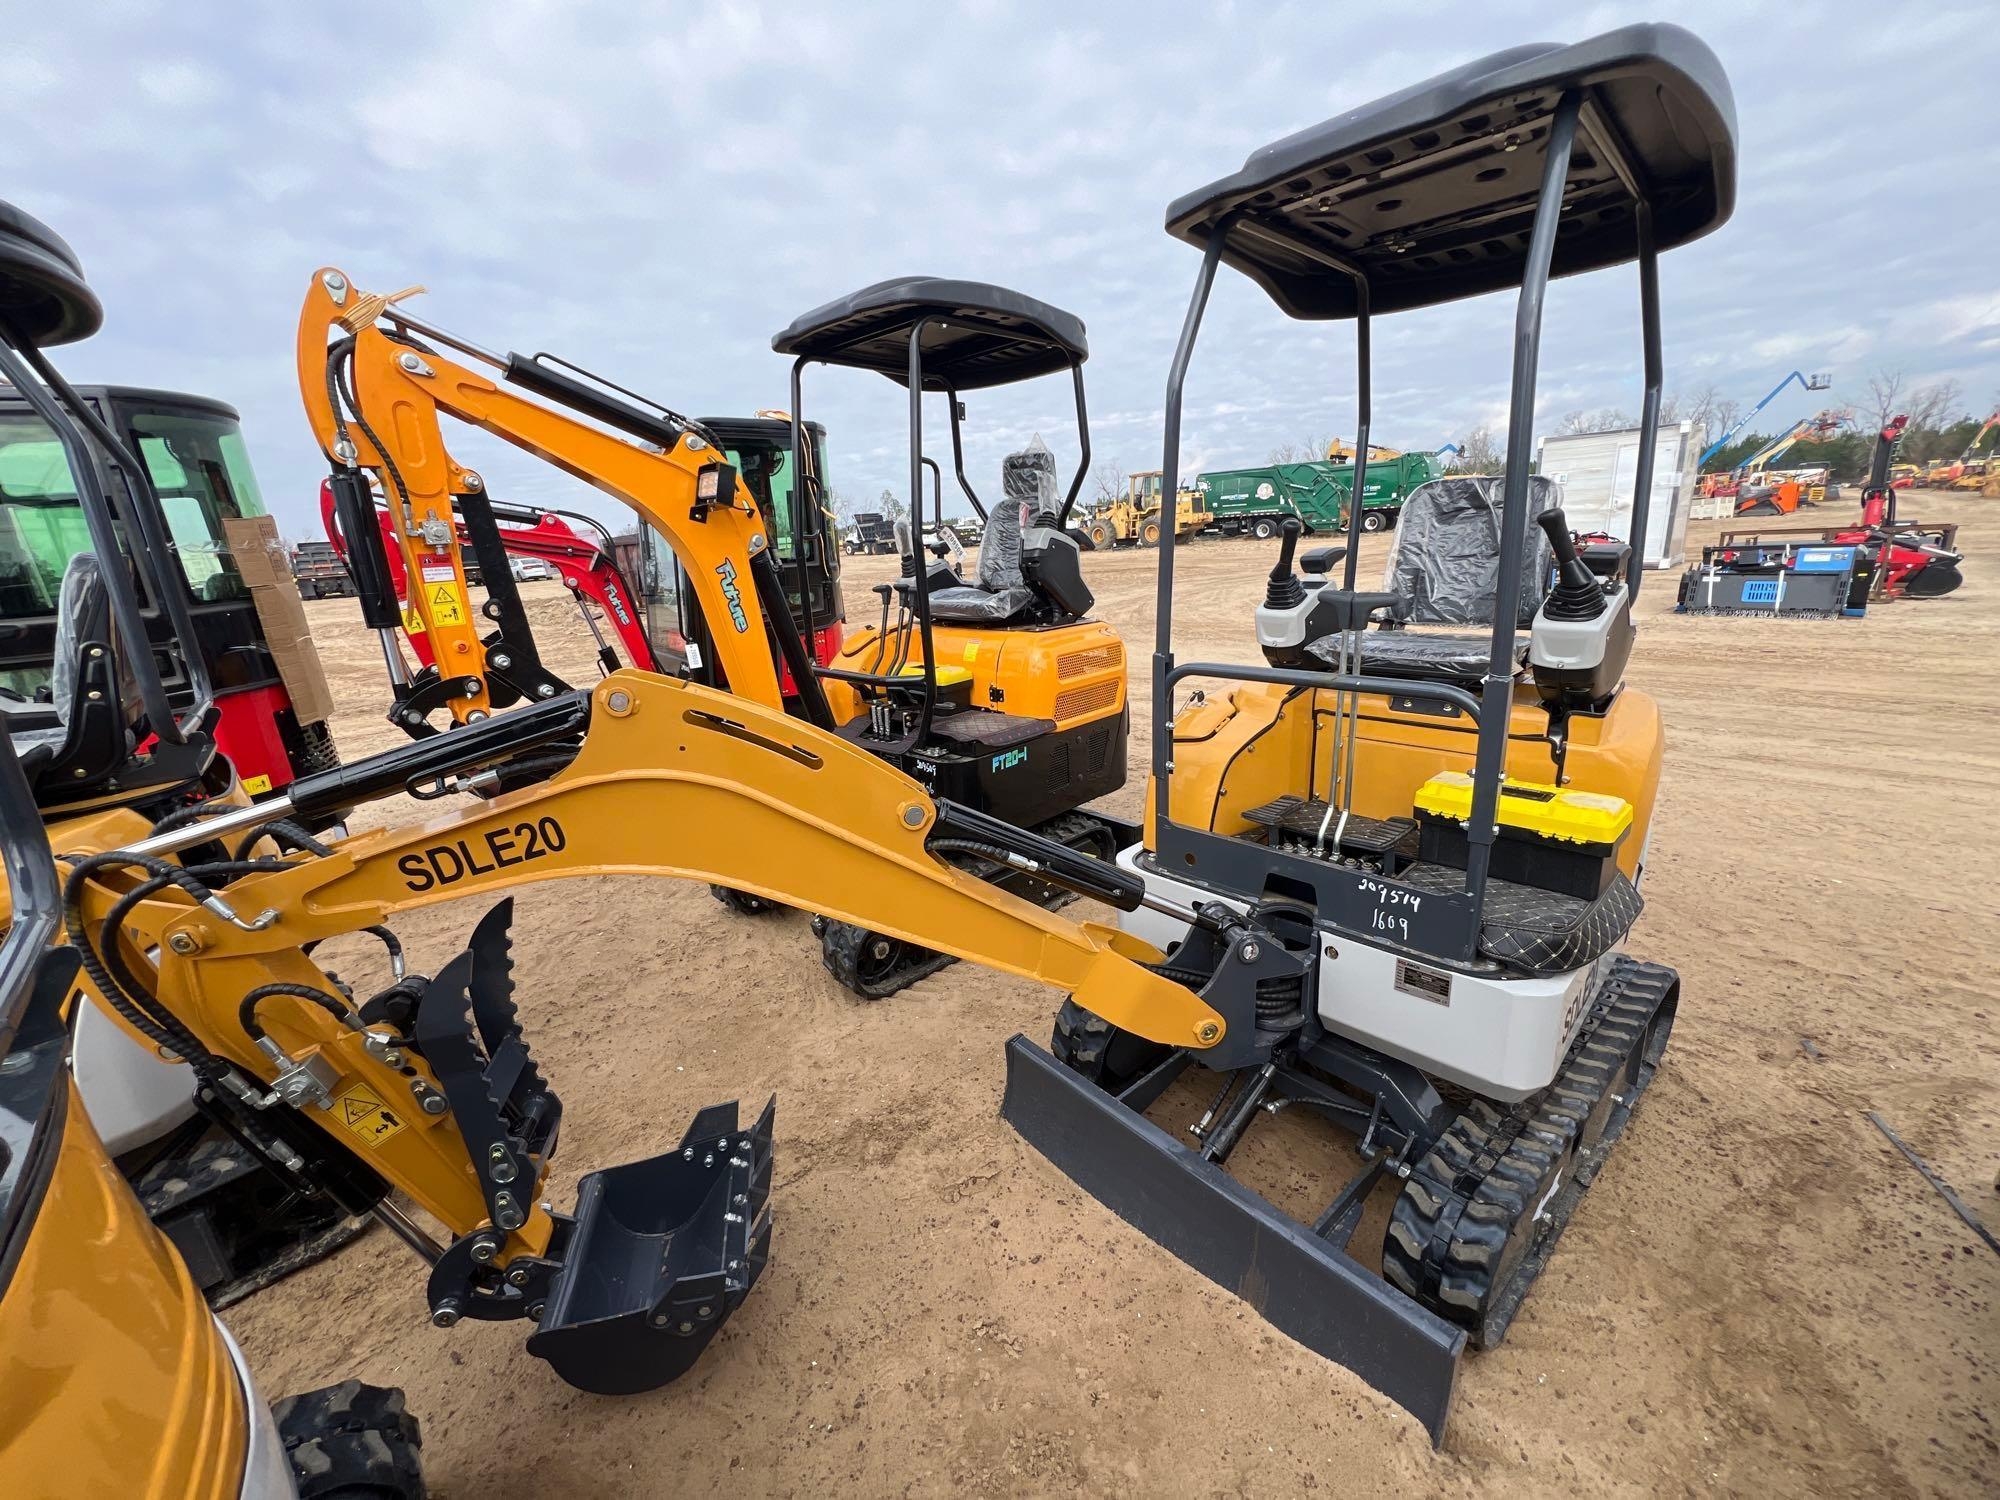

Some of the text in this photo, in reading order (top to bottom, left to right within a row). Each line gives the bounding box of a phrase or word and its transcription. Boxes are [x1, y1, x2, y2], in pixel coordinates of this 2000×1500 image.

[603, 582, 631, 626] Future
[715, 557, 748, 633] Future
[398, 816, 566, 891] SDLE20
[1358, 878, 1421, 912] 209514
[1372, 908, 1408, 940] 1609
